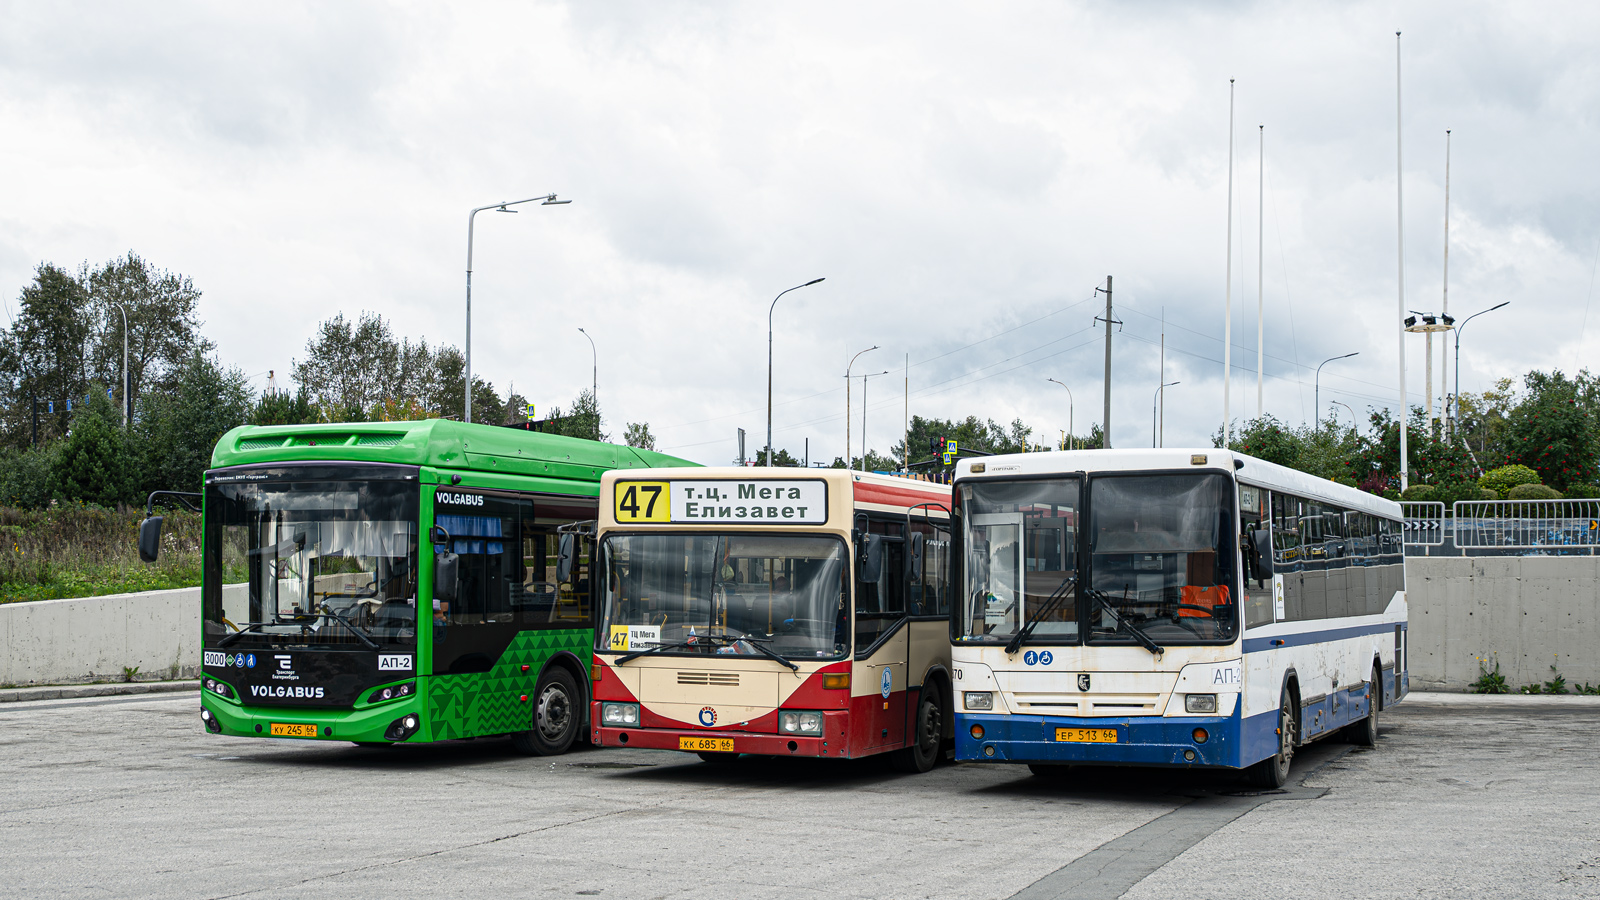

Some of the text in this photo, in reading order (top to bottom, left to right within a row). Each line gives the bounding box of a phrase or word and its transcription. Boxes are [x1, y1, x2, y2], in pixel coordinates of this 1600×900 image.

[436, 492, 484, 506] VOLGABUS
[684, 484, 801, 502] т.ц. Мега
[619, 485, 662, 518] 47
[685, 502, 808, 518] Елизавет
[612, 632, 628, 646] 47
[630, 630, 638, 638] ТЦ
[206, 654, 224, 665] 3000
[381, 658, 410, 668] АП-2
[952, 668, 962, 680] 70
[1214, 668, 1240, 684] АП-2
[250, 685, 324, 698] VOLGABUS
[274, 726, 302, 734] КУ 245
[1062, 730, 1096, 740] ЕР 513
[1103, 730, 1113, 738] 66
[684, 740, 716, 750] КК 685
